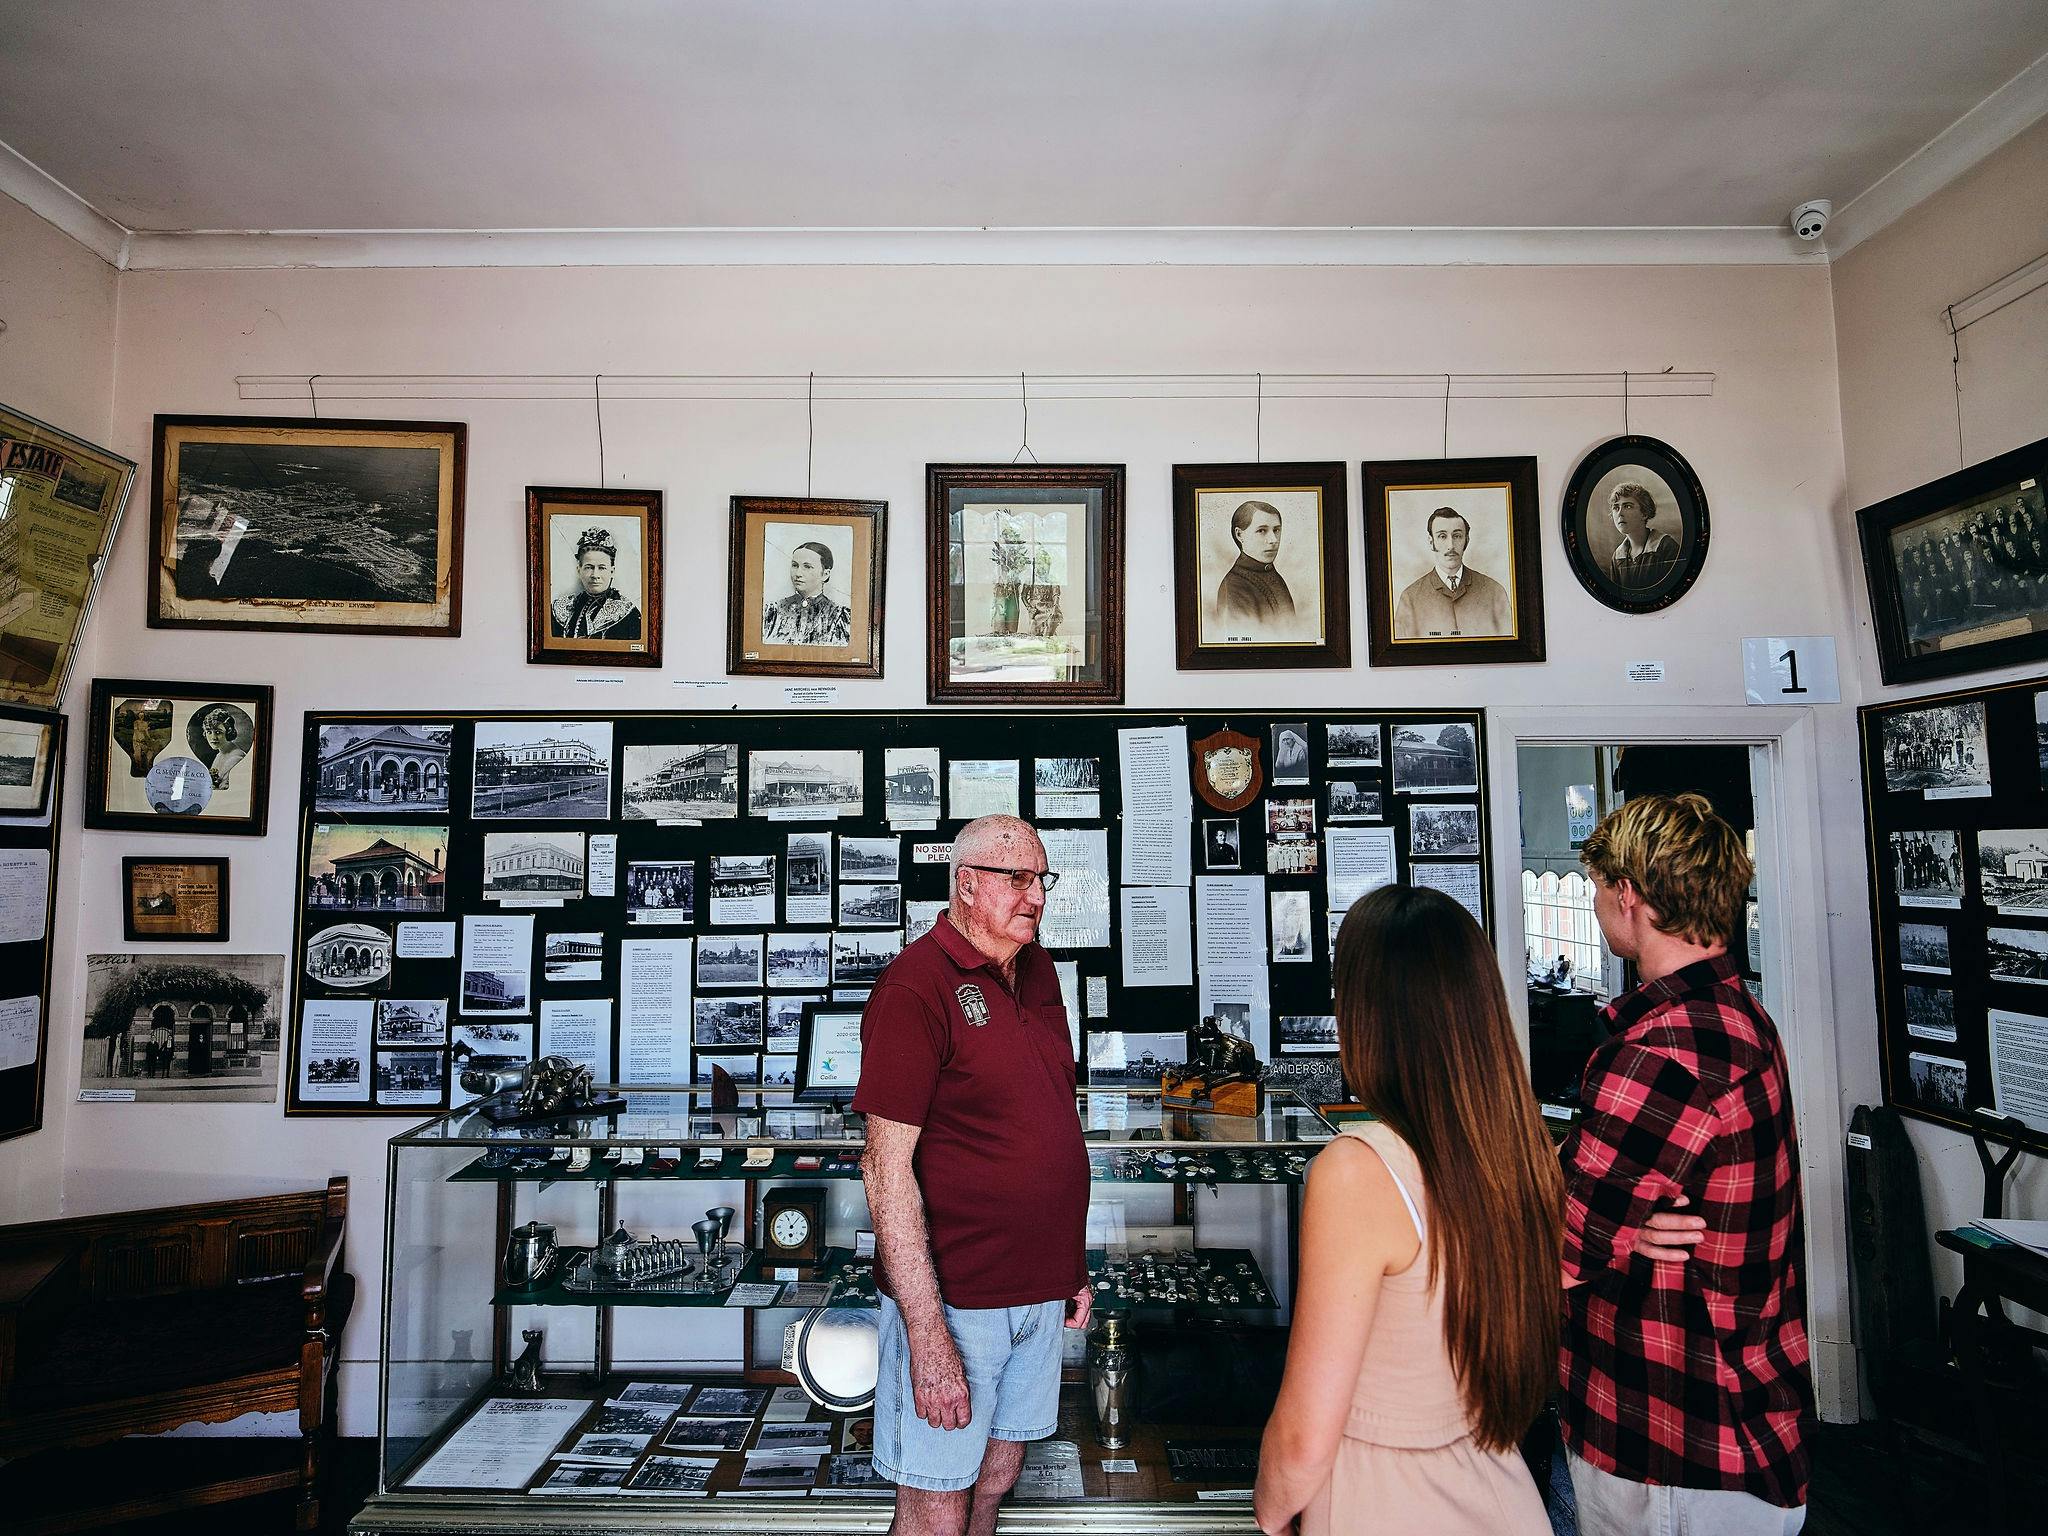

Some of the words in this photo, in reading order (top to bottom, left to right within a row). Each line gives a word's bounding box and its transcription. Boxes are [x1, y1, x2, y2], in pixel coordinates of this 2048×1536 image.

[6, 443, 62, 478] ESTATE
[1779, 649, 1808, 693] 1
[915, 845, 930, 853] NO
[931, 845, 952, 853] SMO
[927, 853, 951, 862] PLEA
[1273, 1063, 1334, 1075] ANDERSON
